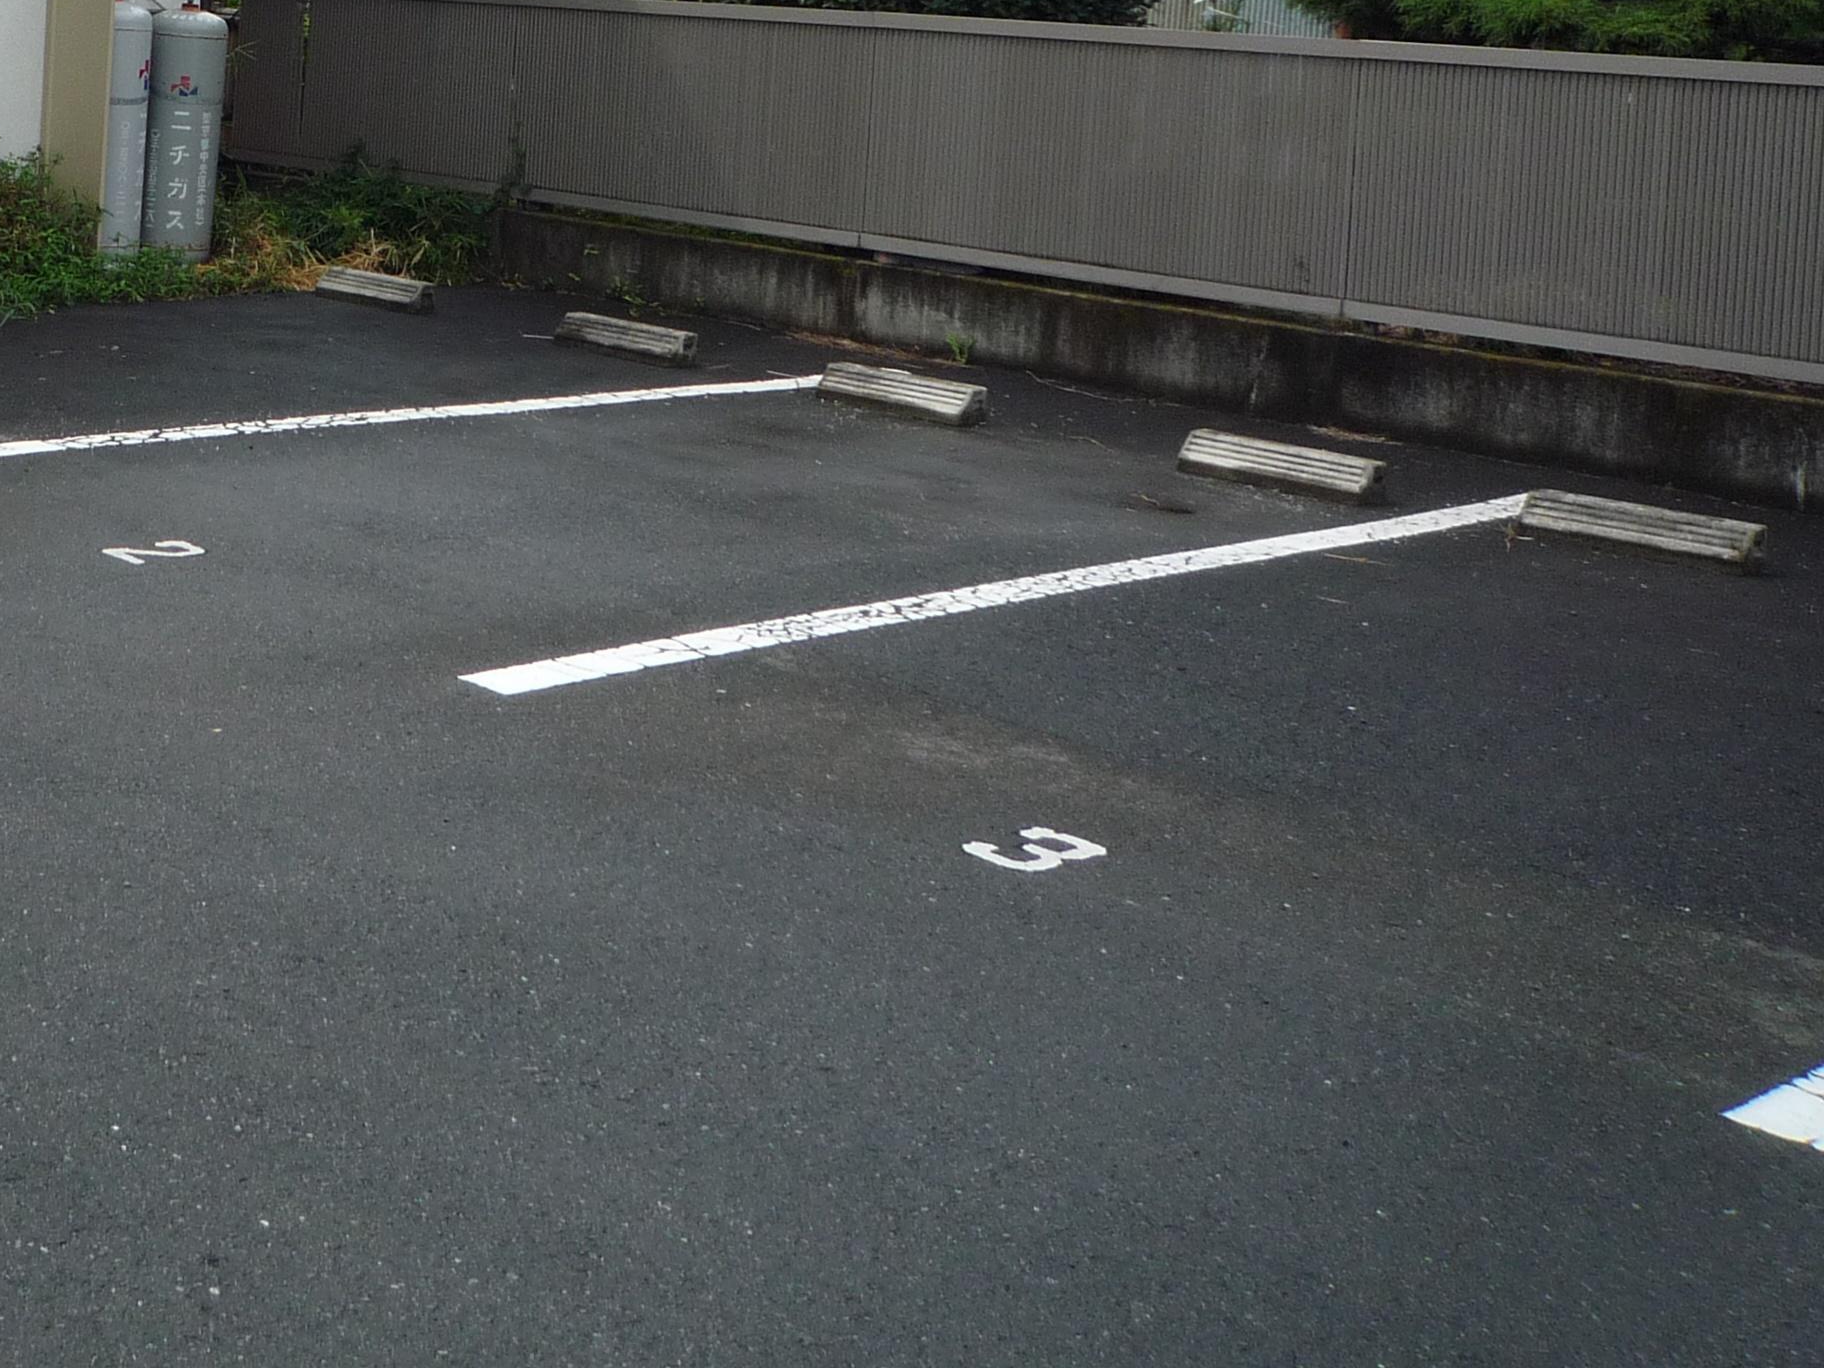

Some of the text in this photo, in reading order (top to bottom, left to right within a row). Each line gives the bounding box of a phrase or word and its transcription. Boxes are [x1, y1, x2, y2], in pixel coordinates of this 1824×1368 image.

[165, 110, 192, 230] ニチガス
[101, 539, 206, 565] 2
[961, 826, 1108, 872] 3
